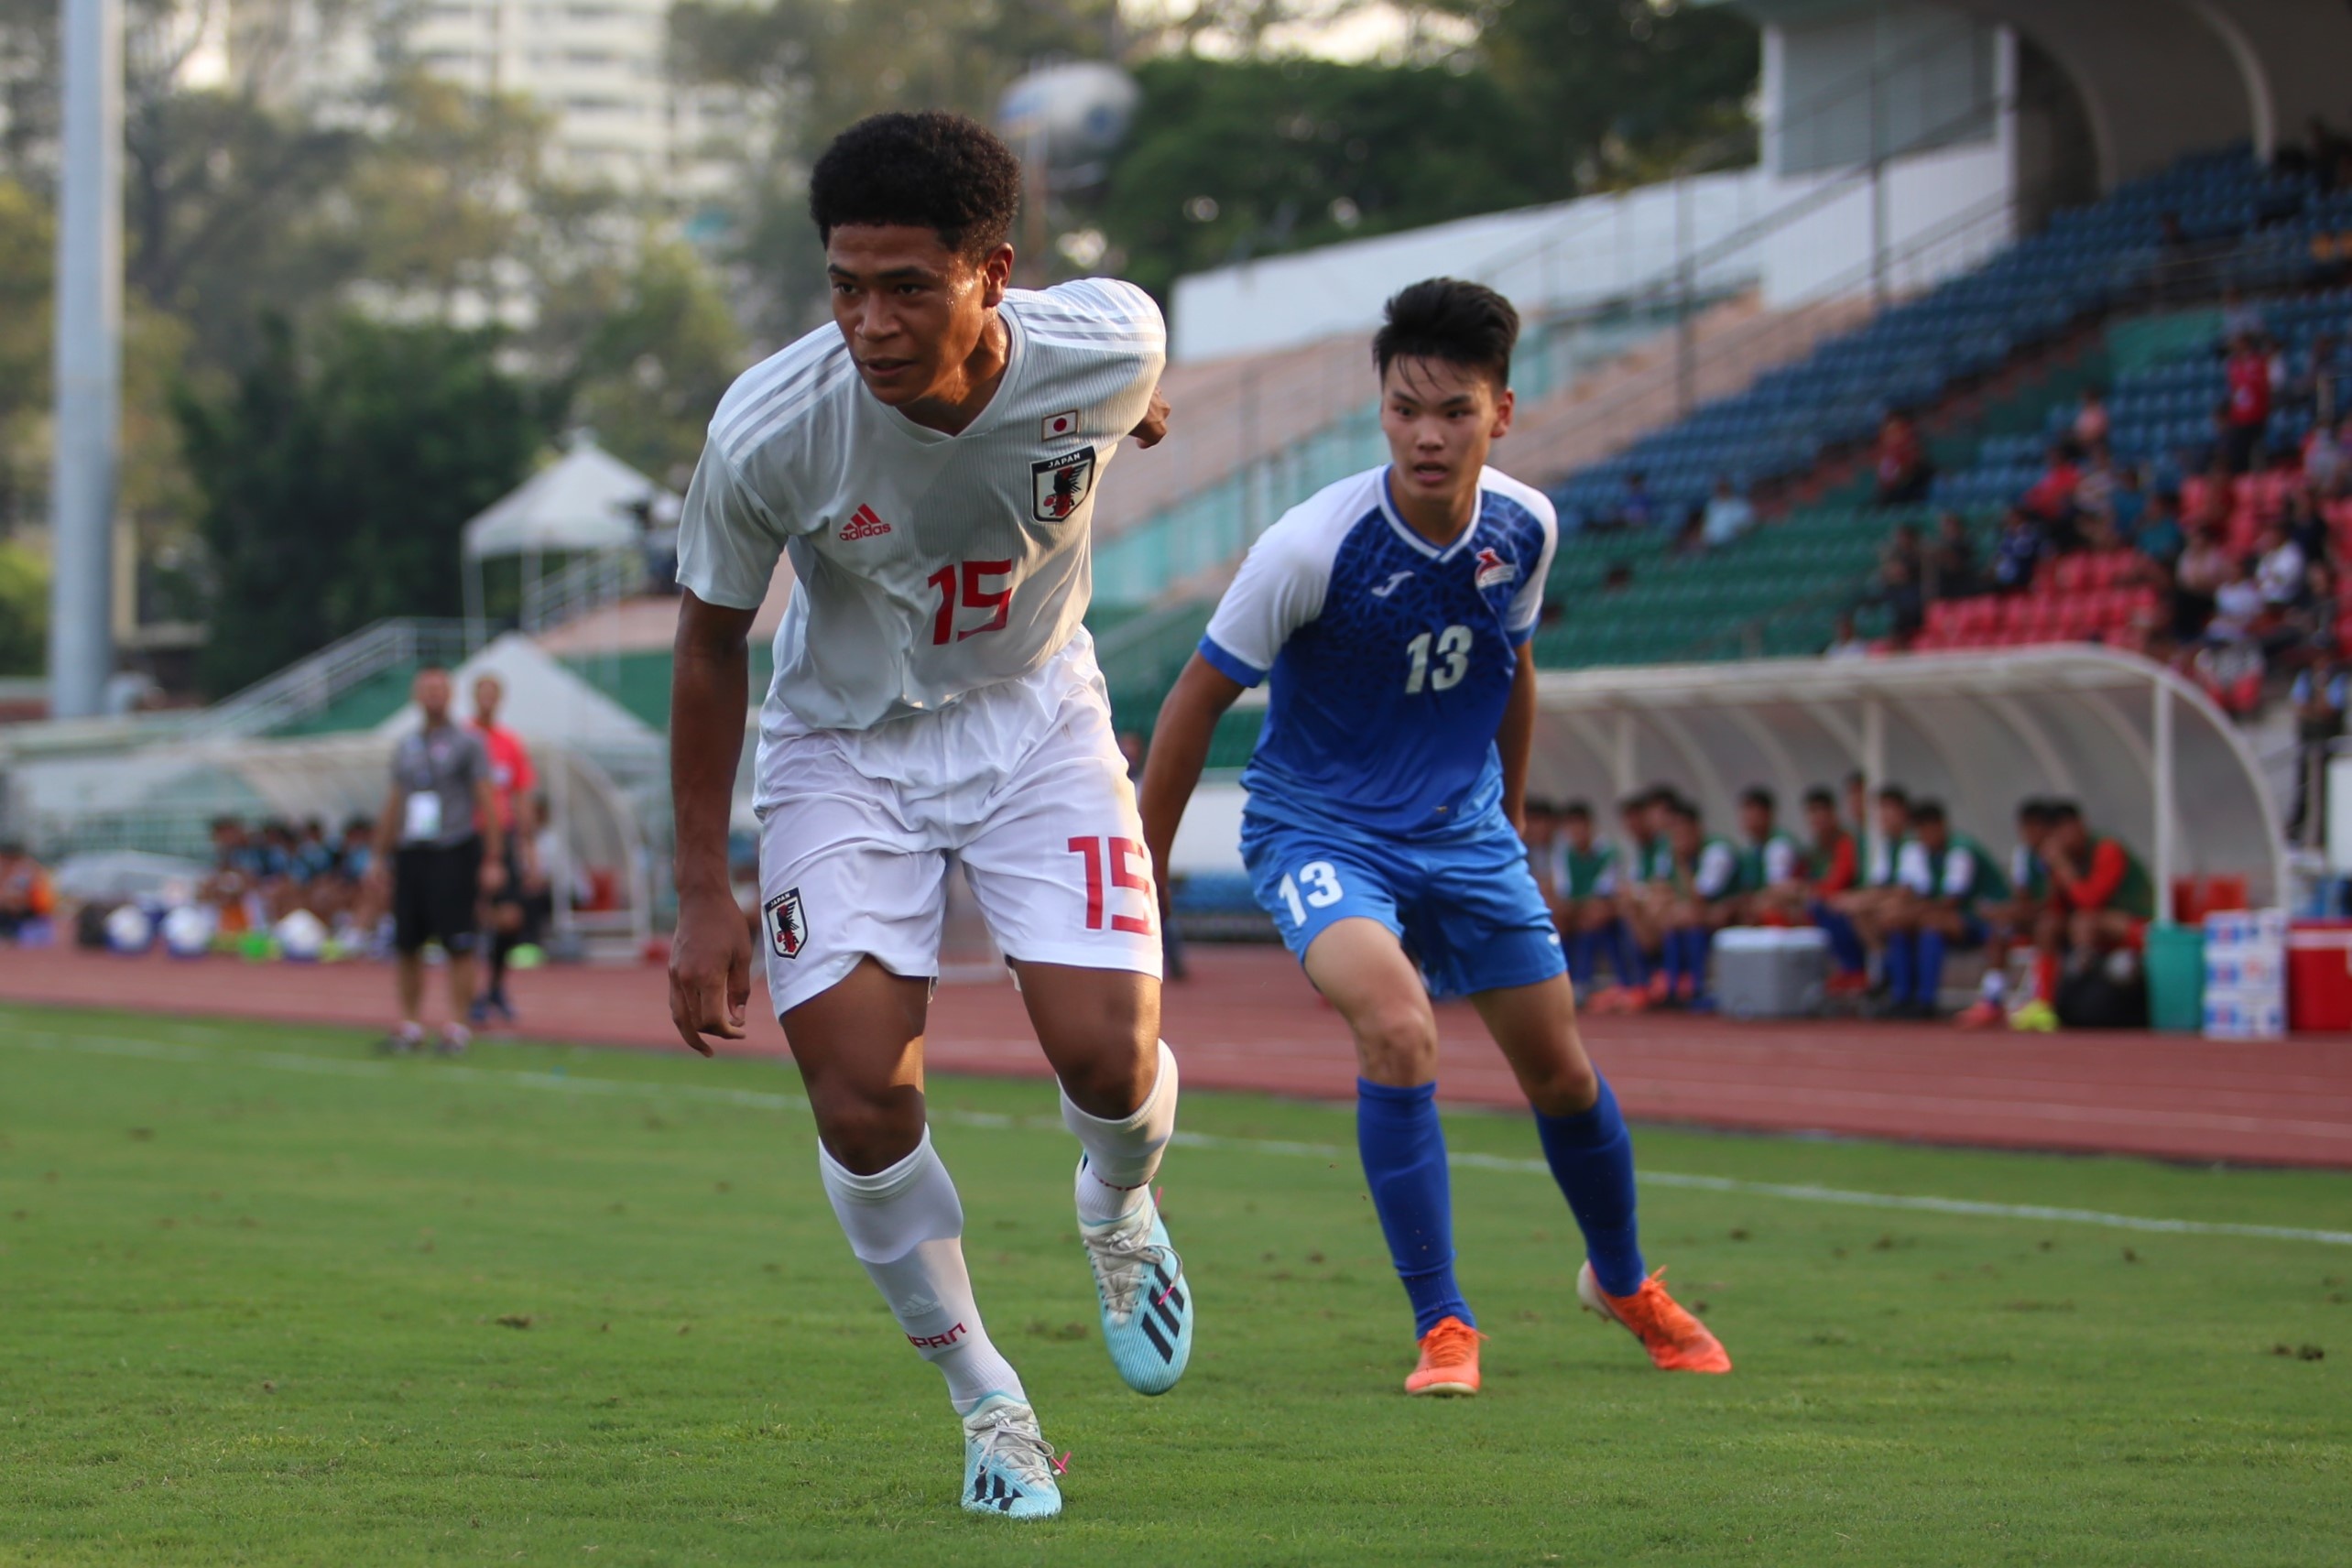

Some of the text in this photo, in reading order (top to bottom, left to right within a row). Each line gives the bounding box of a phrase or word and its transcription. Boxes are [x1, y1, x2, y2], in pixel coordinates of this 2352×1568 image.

[1048, 452, 1081, 468] JAPAN
[839, 522, 892, 541] adidas
[928, 559, 1012, 645] 15
[1405, 625, 1474, 693] 13
[770, 892, 791, 908] JAPAN
[1068, 836, 1154, 937] 15
[1278, 861, 1344, 928] 13
